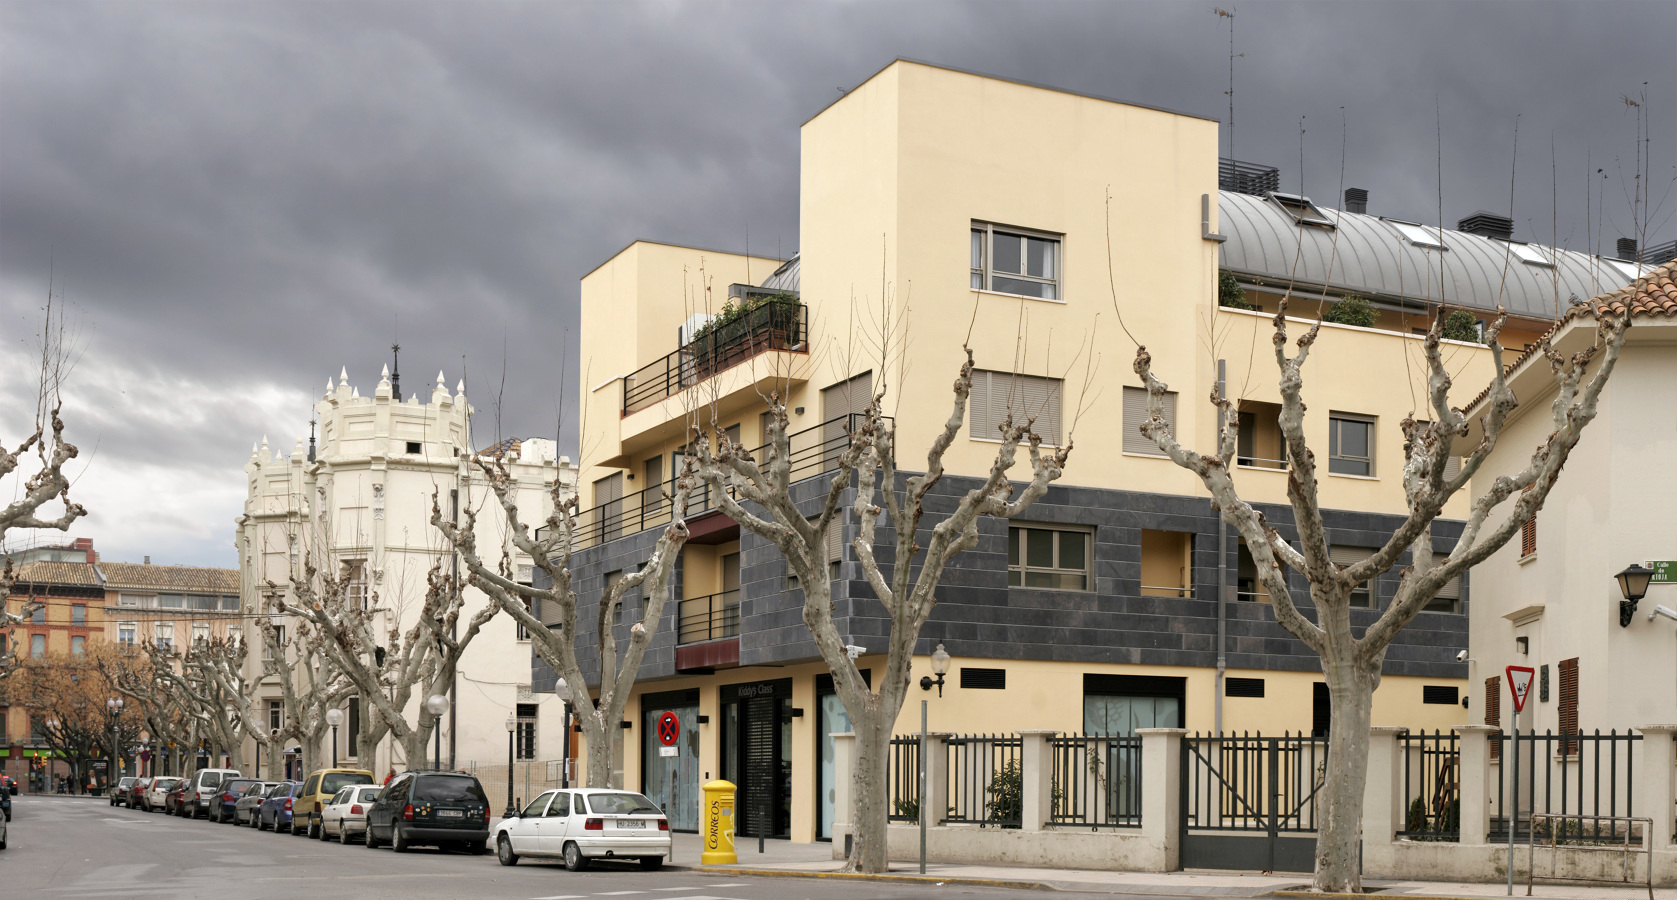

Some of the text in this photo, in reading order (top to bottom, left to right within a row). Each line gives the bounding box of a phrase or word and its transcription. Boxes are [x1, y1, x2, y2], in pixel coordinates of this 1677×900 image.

[738, 684, 774, 698] Kiddy's Class
[708, 800, 720, 850] CORREOS
